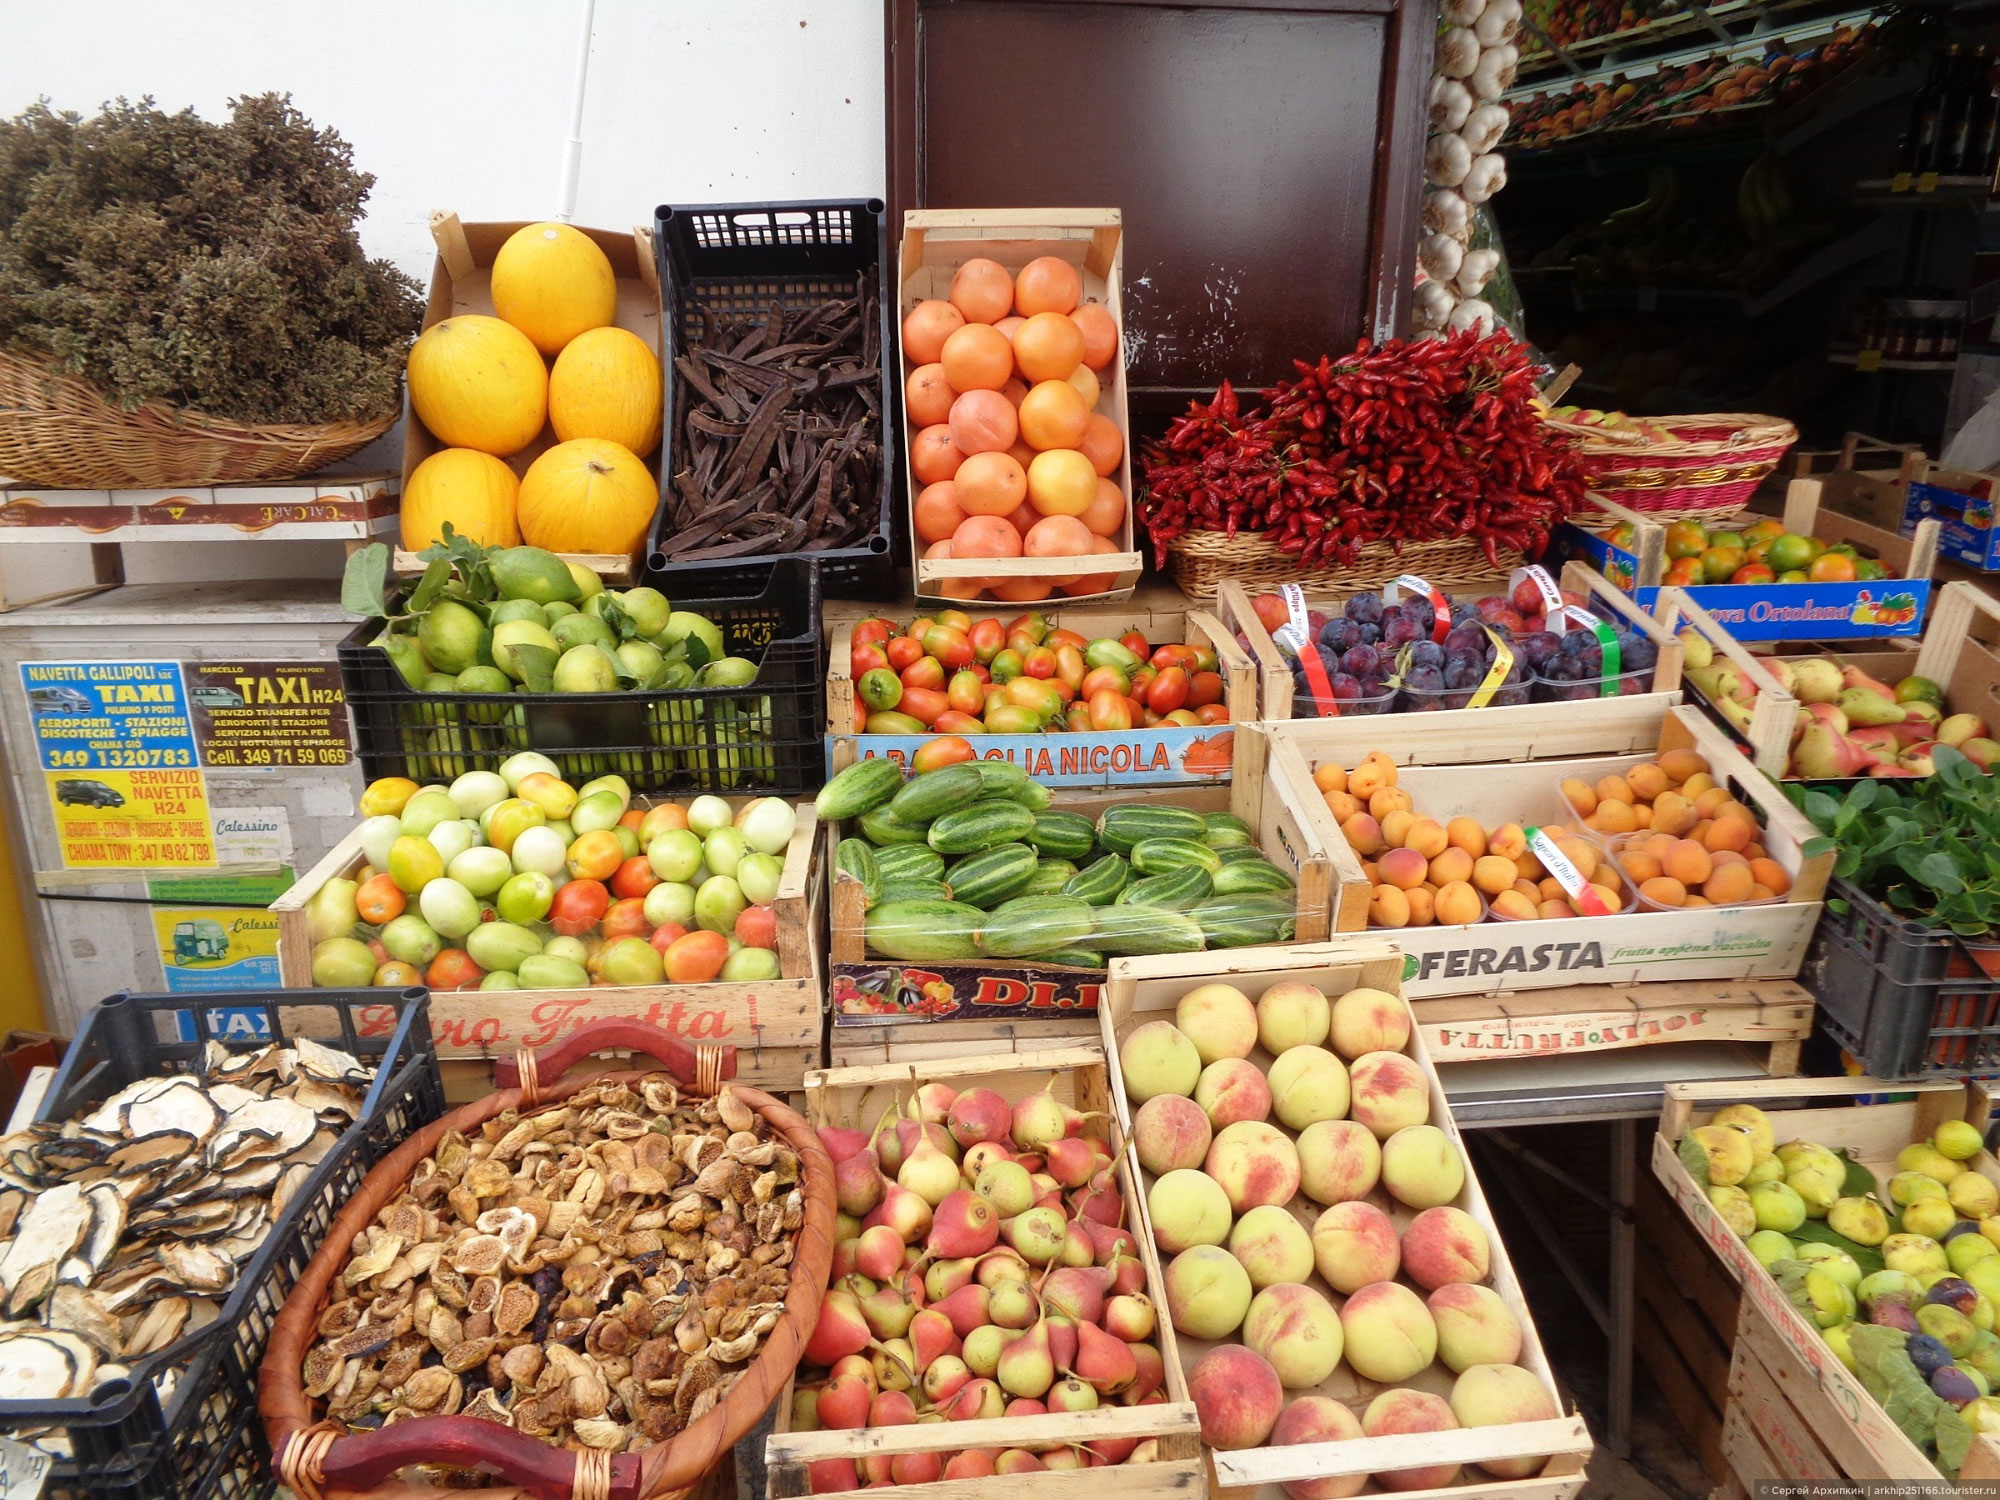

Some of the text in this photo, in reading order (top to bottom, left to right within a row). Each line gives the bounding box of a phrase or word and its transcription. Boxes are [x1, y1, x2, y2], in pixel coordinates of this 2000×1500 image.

[1749, 599, 1850, 623] Ortolana
[28, 666, 86, 681] NAVETTA
[89, 665, 155, 681] GALLIPOLI
[200, 666, 244, 674] MARCELLO
[94, 684, 175, 703] TAXI
[235, 677, 344, 704] TAXI H24
[104, 705, 175, 715] PULMINO 9 POSTI
[207, 708, 331, 717] SERVIZIO TRANSFER PER
[38, 718, 111, 728] AEROPORTI
[125, 717, 186, 727] STAZIONI
[214, 719, 270, 727] AEROPORTI
[281, 718, 328, 726] STAZIONI
[40, 728, 116, 739] DISCOTECHE
[130, 727, 188, 738] SPIAGGE
[214, 728, 331, 737] SERVIZIO NAVETTA PER
[89, 740, 123, 750] CHIAMA
[202, 739, 239, 748] LOCALI
[240, 739, 292, 747] NOTTURNI
[303, 738, 345, 746] SPIAGGE
[49, 749, 190, 767] 349 1320783
[206, 748, 346, 765] Cell. 349 71 59 069
[1060, 742, 1171, 776] NICOLA
[129, 770, 199, 785] SERVIZIO
[132, 786, 202, 800] NAVETTA
[154, 801, 186, 815] H24
[216, 819, 278, 836] Calessino
[67, 843, 107, 861] CHIAMA
[107, 843, 132, 861] TONY
[139, 843, 158, 861] 347
[161, 843, 174, 860] 49
[175, 843, 189, 860] 82
[190, 843, 211, 860] 798
[1610, 938, 1773, 960] frutta appena raccolta
[1418, 941, 1605, 981] FERASTA
[359, 1005, 509, 1047] Ero
[1600, 1008, 1709, 1043] JOLLY
[1440, 1029, 1586, 1051] FRUTTA
